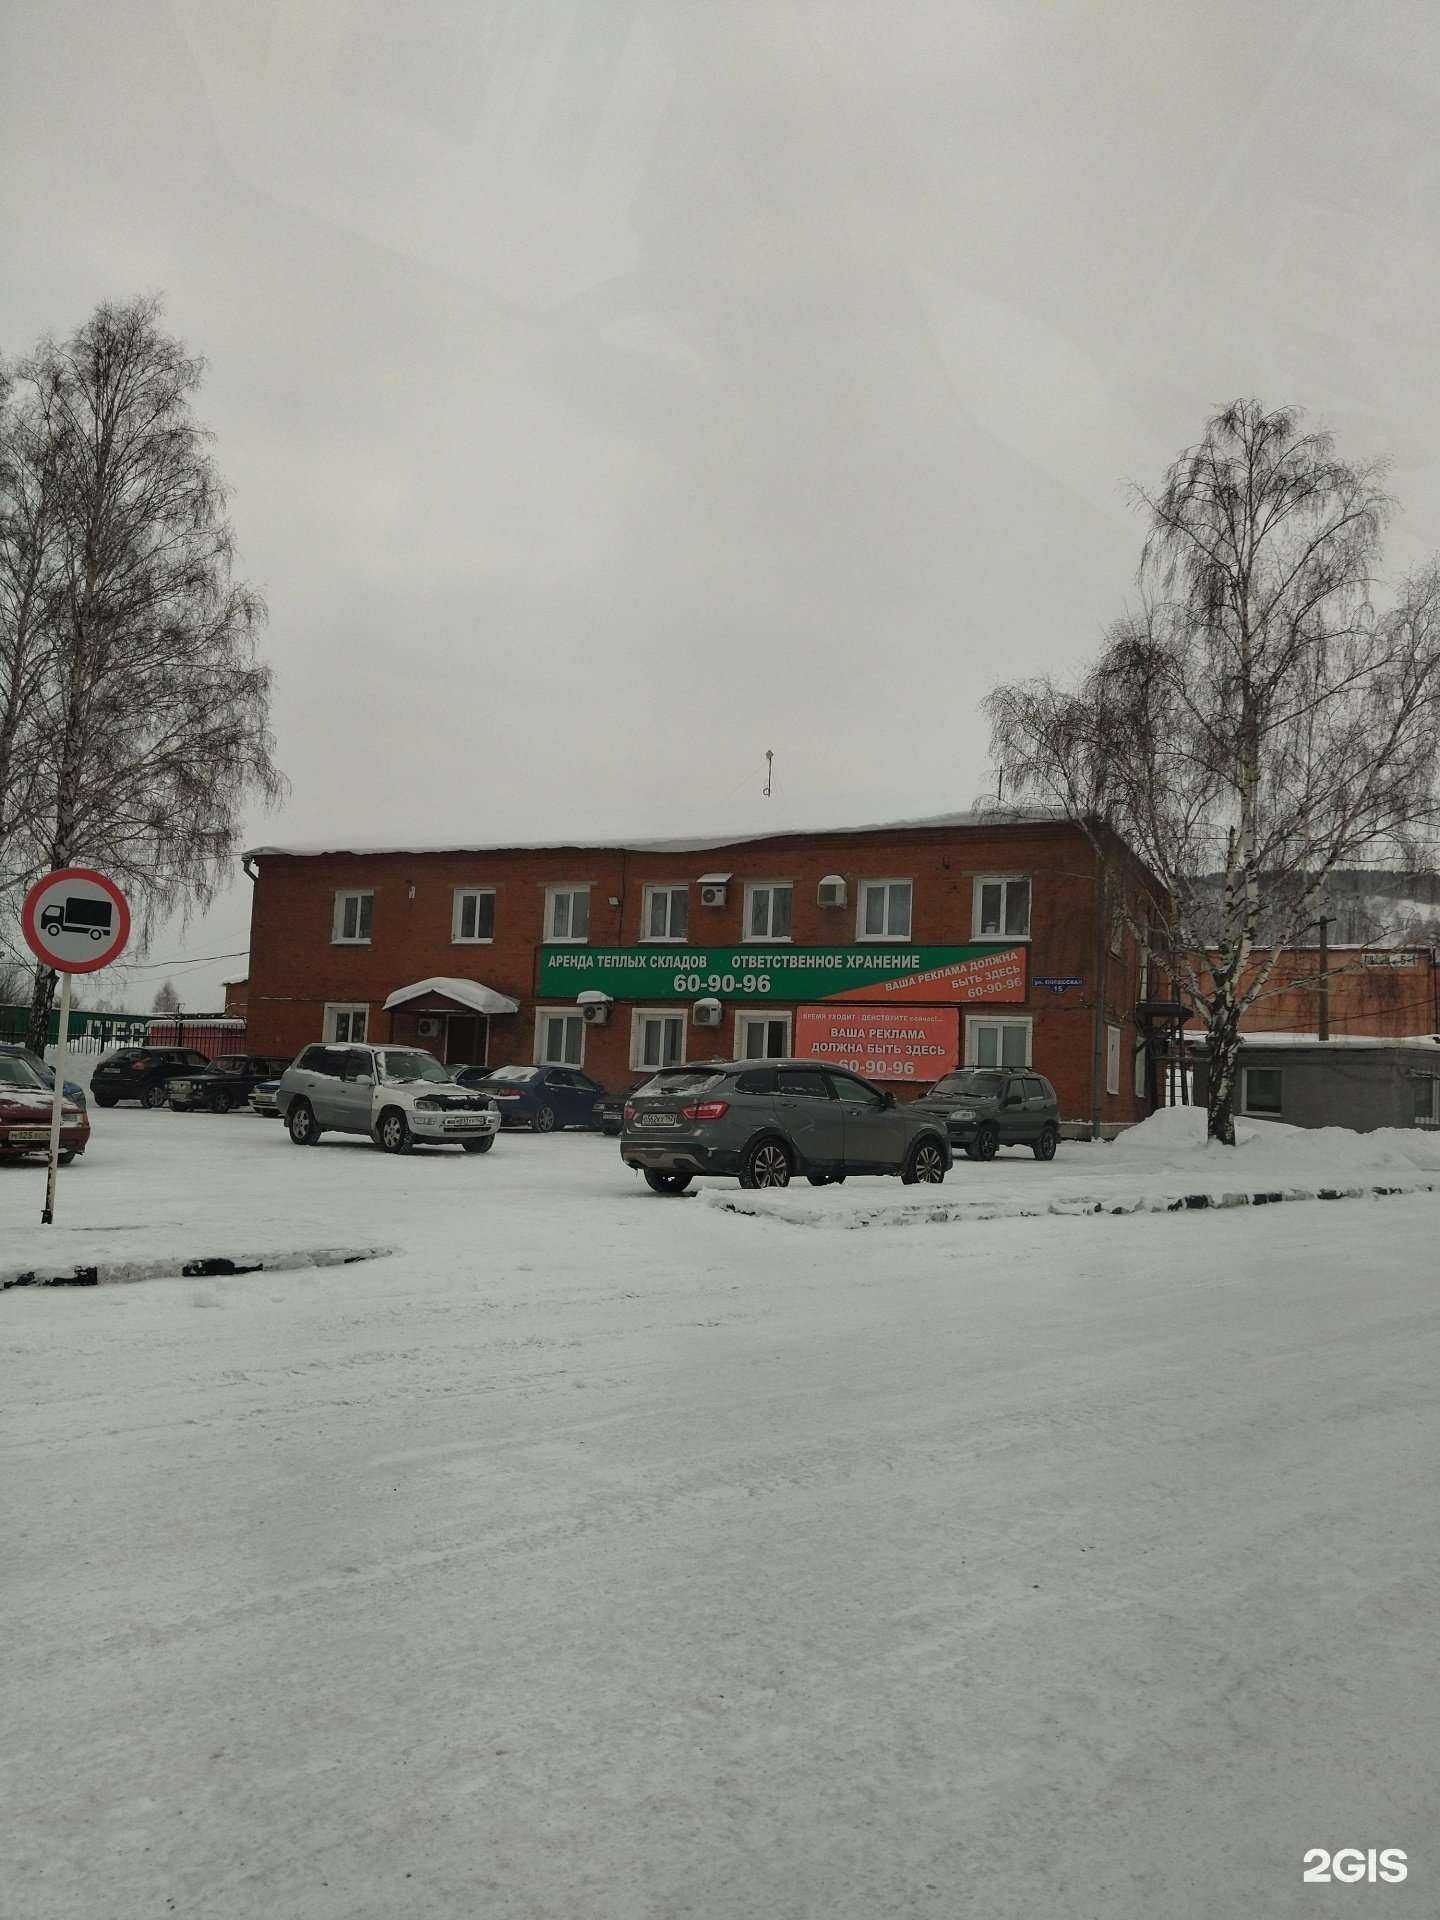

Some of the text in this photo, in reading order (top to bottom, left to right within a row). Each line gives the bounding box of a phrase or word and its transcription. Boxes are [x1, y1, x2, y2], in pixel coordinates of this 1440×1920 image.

[548, 955, 920, 970] АРЕНДА ТЕПЛЫХ СКЛАДОВ ОТВЕТСТВЕННОЕ ХРАНЕНИЕ
[885, 952, 1018, 992] ВАША РЕКЛАМА ДОЛЖНА
[951, 965, 1021, 989] БЫТЬ ЗДЕСЬ
[673, 973, 771, 993] 60-90-96
[968, 977, 1022, 998] 60-90-96
[831, 1027, 926, 1040] ВАША РЕКЛАМА
[811, 1042, 945, 1057] ДОЛЖНА БЫТЬ ЗДЕСЬ
[838, 1059, 915, 1075] 60-90-96
